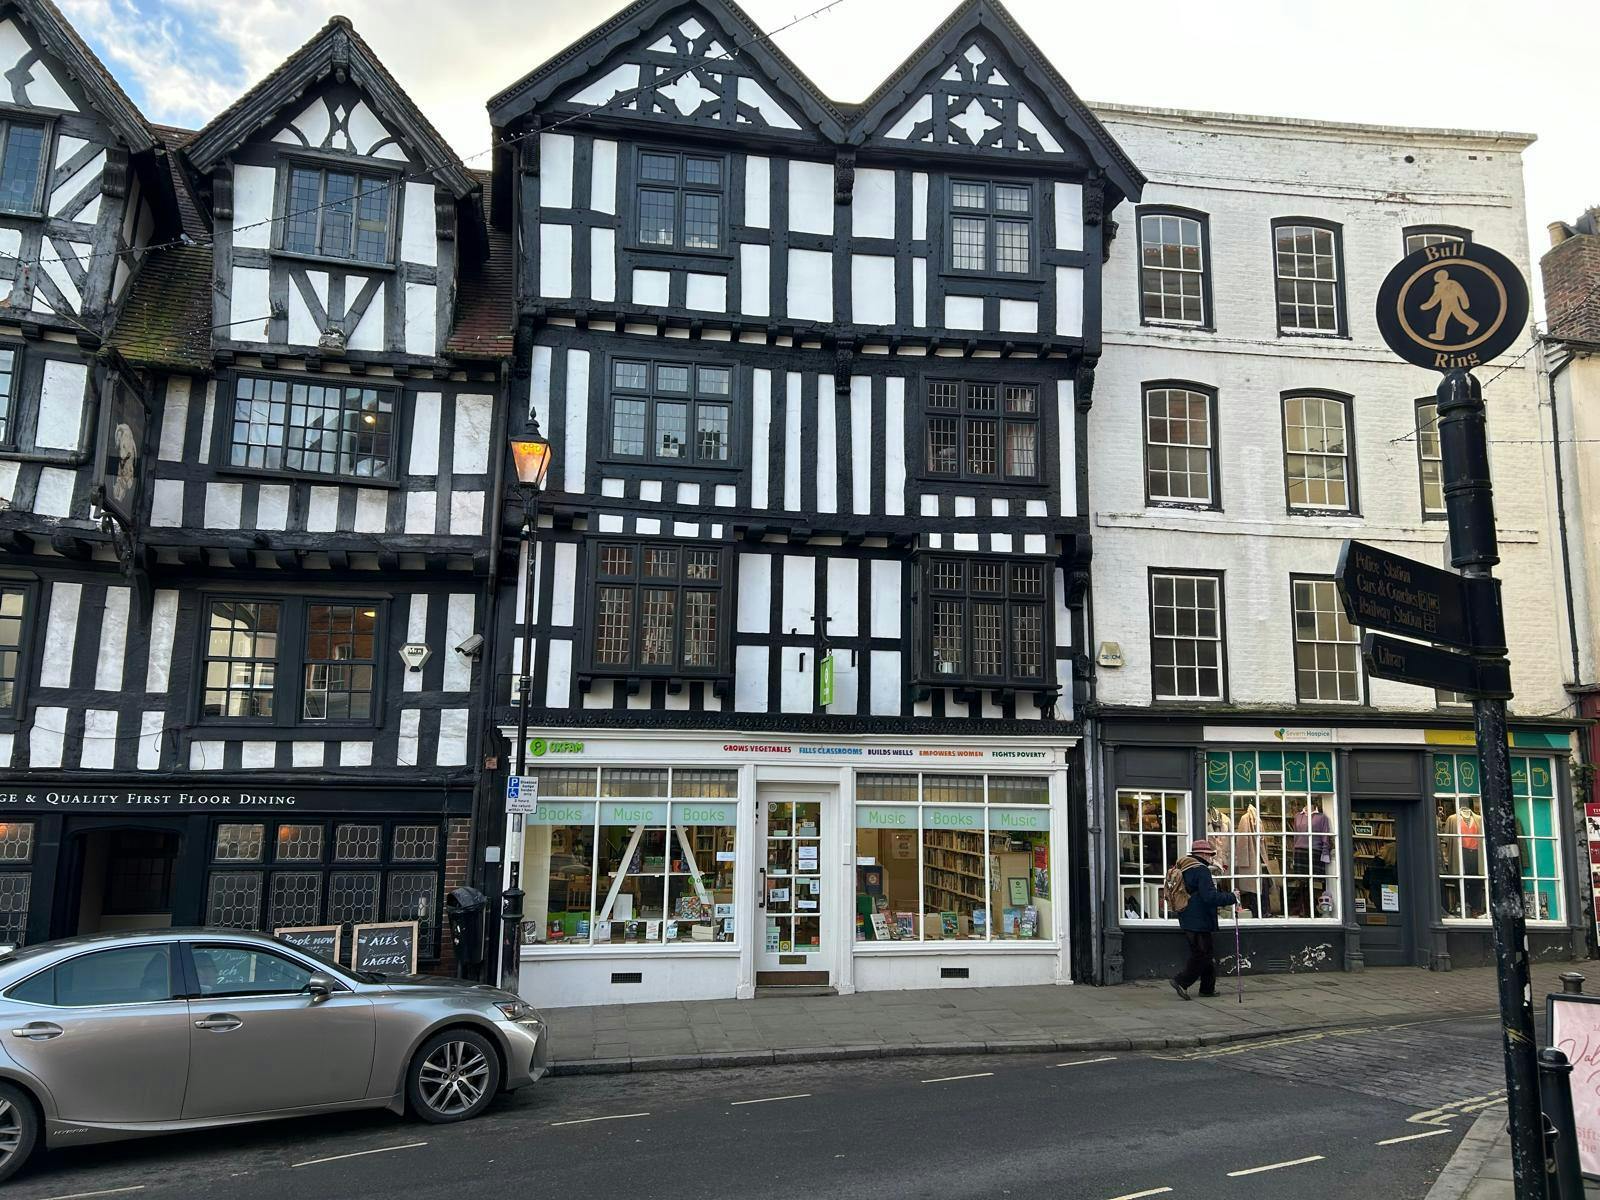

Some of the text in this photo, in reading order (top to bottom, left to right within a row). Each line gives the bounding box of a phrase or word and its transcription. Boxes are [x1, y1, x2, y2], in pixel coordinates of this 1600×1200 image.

[1424, 242, 1465, 261] Bull
[1434, 351, 1480, 368] Ring
[1355, 551, 1411, 584] Police Station
[1356, 574, 1377, 593] Cars
[1377, 581, 1386, 597] &
[1386, 583, 1418, 607] Coaches
[1359, 596, 1422, 628] Railway Station
[1377, 645, 1406, 672] Library
[548, 741, 585, 754] OXFAM
[749, 745, 792, 753] VEGETABLES
[799, 746, 816, 754] FILLS
[817, 747, 863, 755] CLASSROOMS
[867, 748, 891, 756] BUILDS
[511, 778, 518, 787] P
[26, 794, 37, 804] &
[46, 792, 119, 805] QUALITY
[127, 793, 171, 804] FIRST
[179, 793, 230, 804] FLOOR
[239, 793, 296, 805] DINING
[539, 806, 582, 820] Books
[614, 807, 653, 821] Music
[683, 807, 724, 821] Books
[869, 811, 906, 824] Music
[933, 812, 973, 825] Books
[1001, 813, 1036, 827] Music
[284, 932, 336, 946] Book now
[369, 935, 399, 946] ALES
[362, 955, 406, 966] LAGERS
